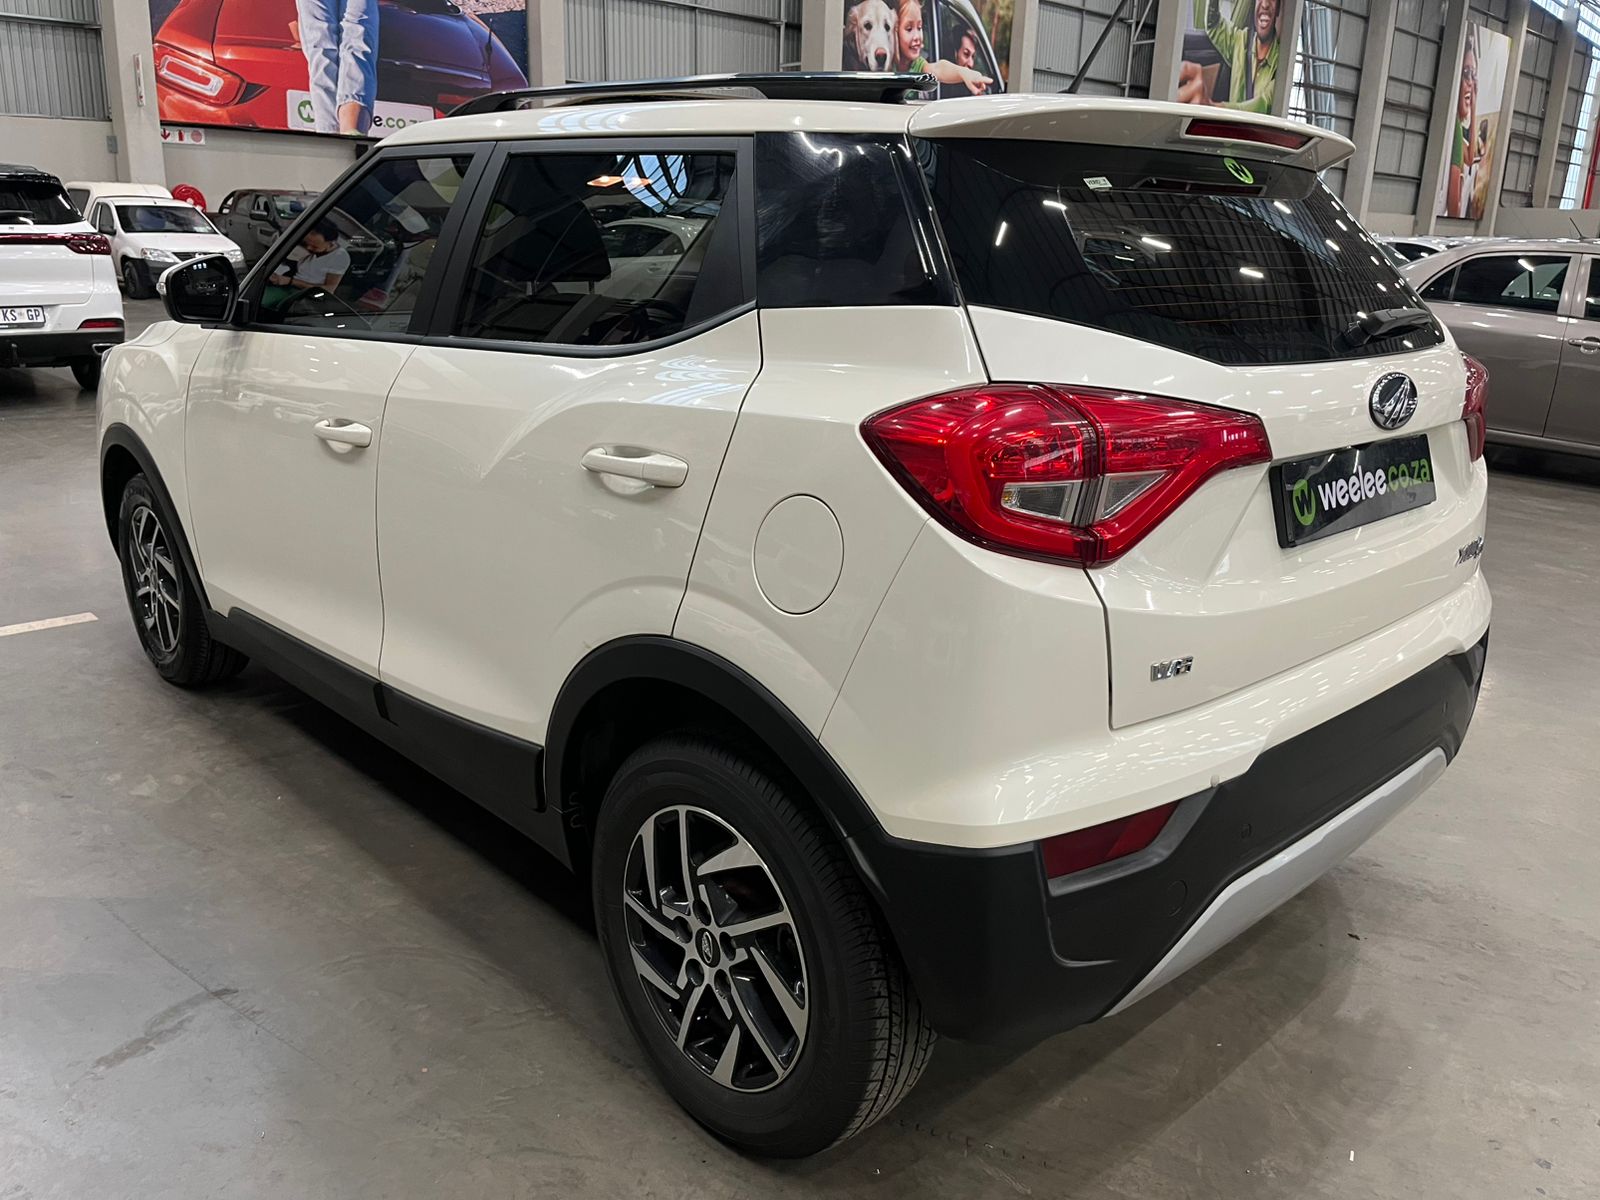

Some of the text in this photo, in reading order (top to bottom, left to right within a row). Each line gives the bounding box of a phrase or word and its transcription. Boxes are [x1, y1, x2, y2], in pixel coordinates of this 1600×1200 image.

[2, 309, 40, 321] KS GP
[1317, 458, 1431, 511] weelee.co.za
